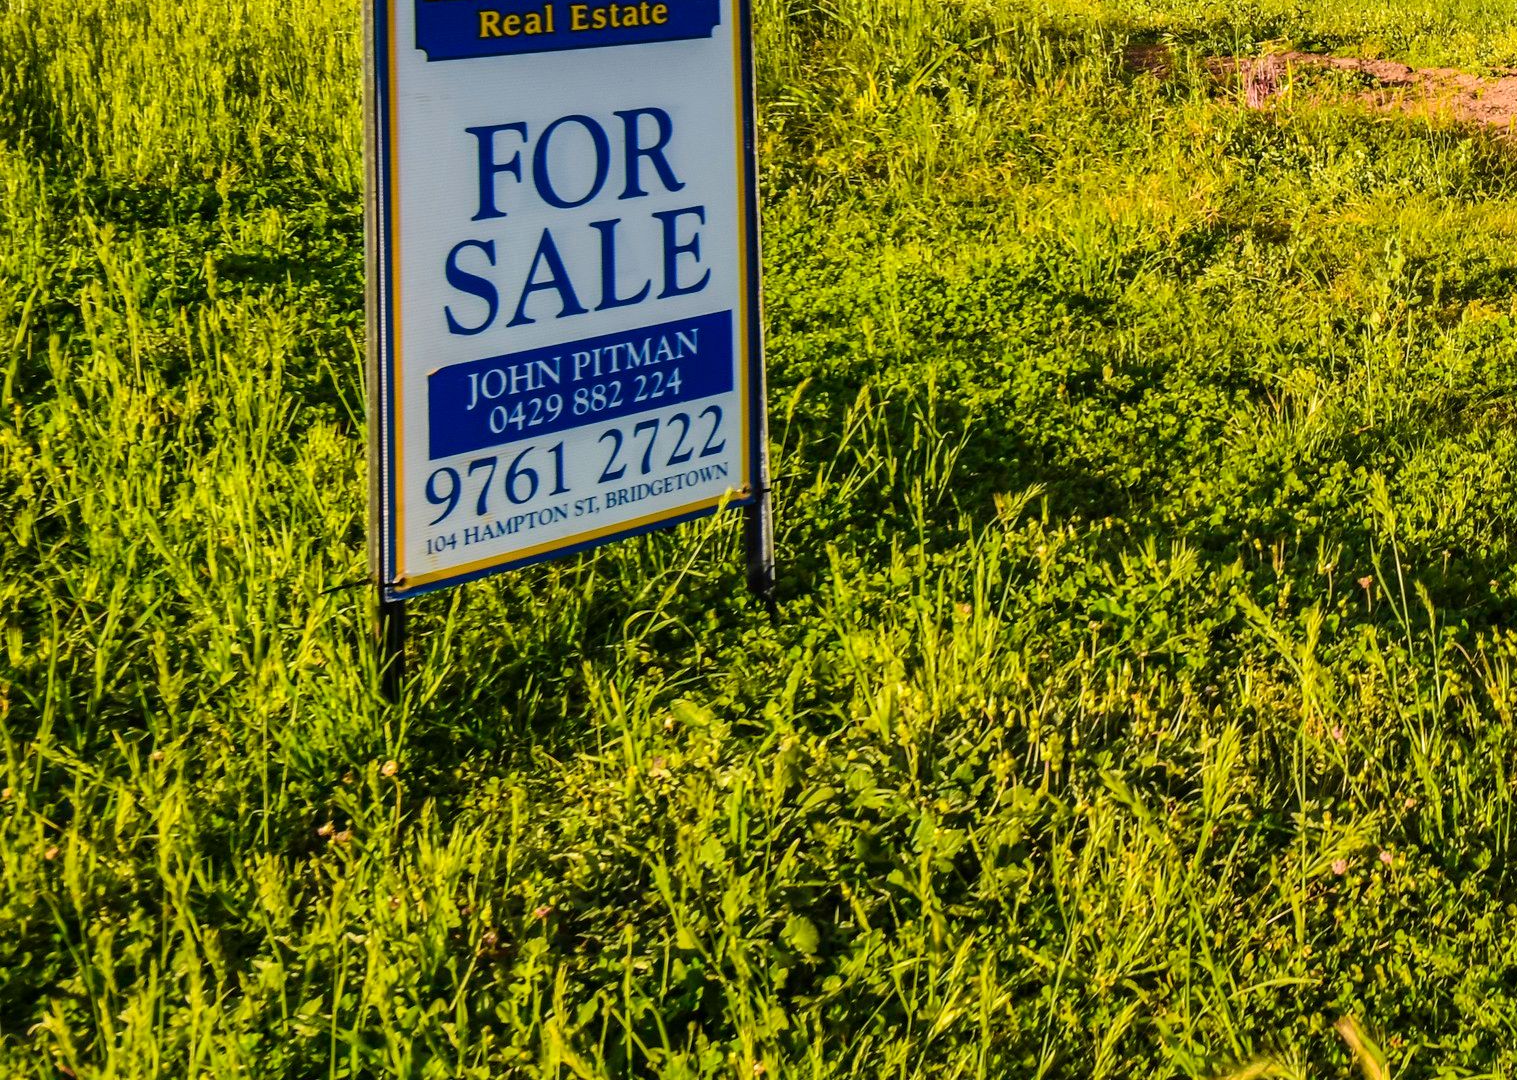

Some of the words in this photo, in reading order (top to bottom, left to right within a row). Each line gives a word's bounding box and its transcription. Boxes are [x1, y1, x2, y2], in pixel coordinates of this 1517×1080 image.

[479, 4, 554, 38] Real
[570, 1, 668, 31] Estate
[465, 107, 685, 221] FOR
[444, 205, 711, 336] SALE
[467, 357, 560, 410] JOHN
[572, 328, 699, 381] PITMAN
[489, 394, 563, 434] 0429
[573, 384, 623, 416] 882
[633, 368, 682, 402] 224
[425, 443, 571, 526] 9761
[597, 404, 726, 484] 2722
[426, 533, 456, 555] 104
[464, 503, 568, 545] HAMPTON
[574, 496, 600, 517] ST,
[605, 462, 729, 509] BRIDGETOWN
